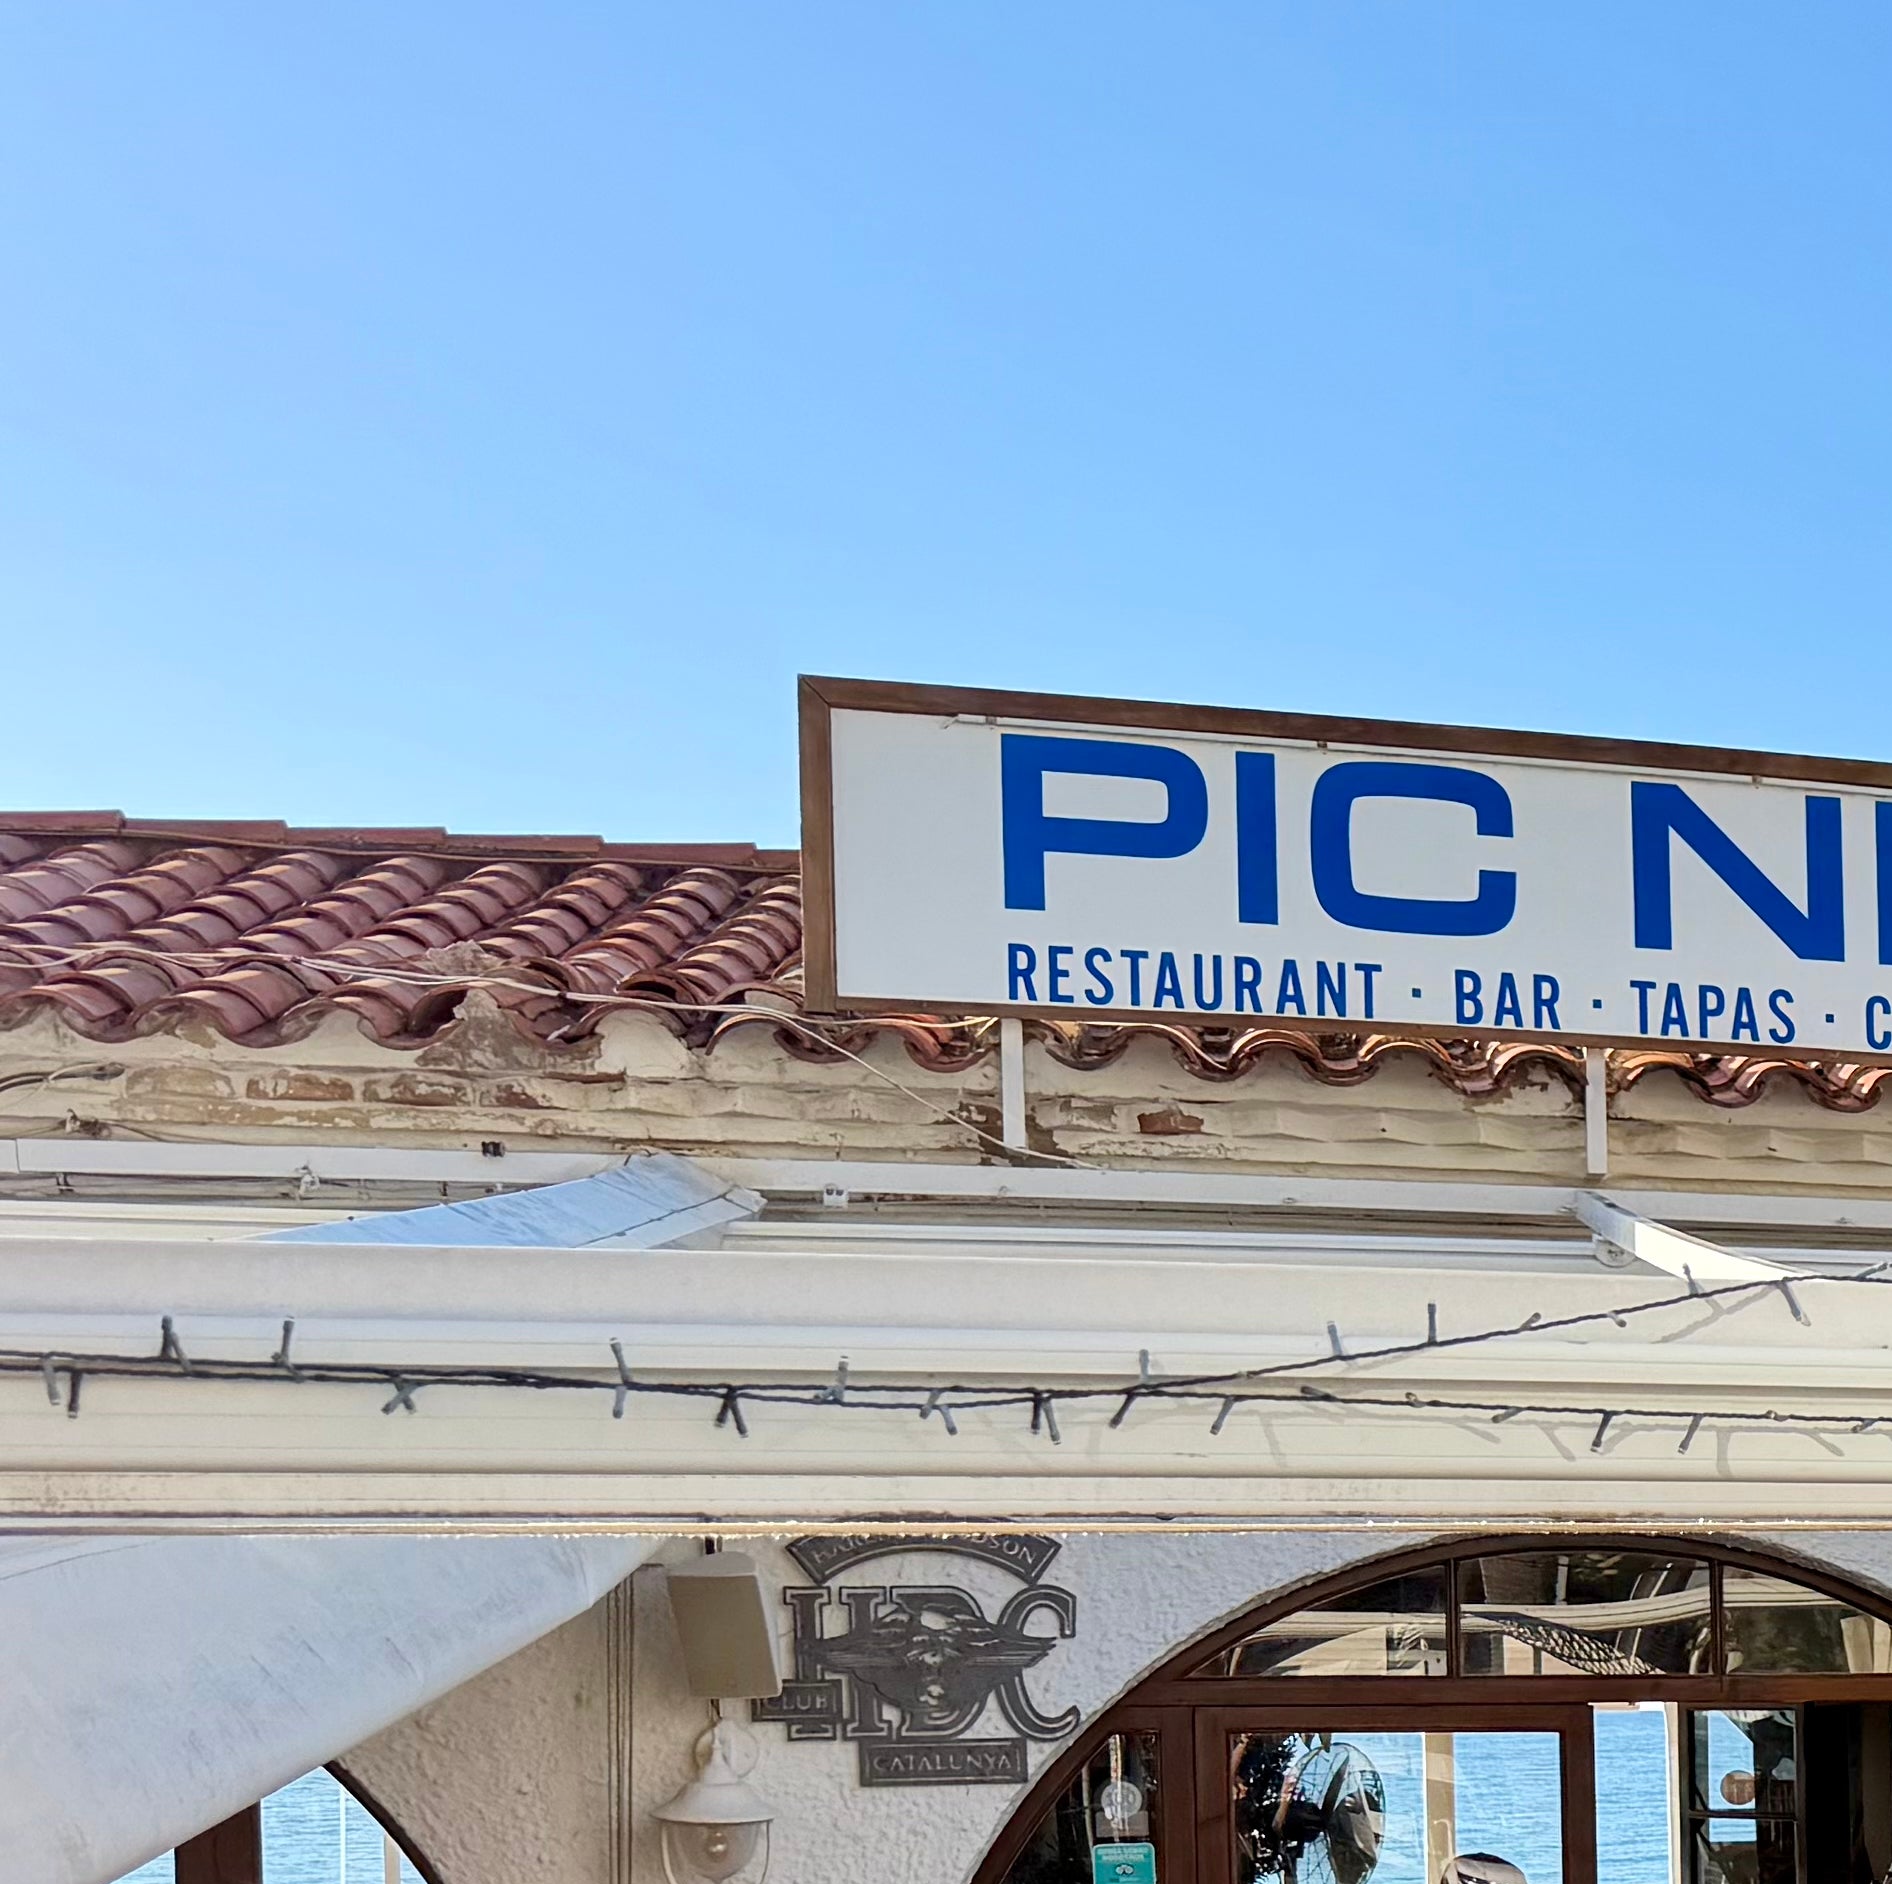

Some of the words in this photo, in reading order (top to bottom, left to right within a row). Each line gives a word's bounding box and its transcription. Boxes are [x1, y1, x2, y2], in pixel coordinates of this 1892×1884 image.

[1000, 732, 1517, 937] PIC
[1007, 942, 1383, 1019] RESTAURANT
[1453, 968, 1562, 1031] BAR
[1629, 979, 1796, 1045] TAPAS
[872, 1753, 1012, 1772] CATALUNYA
